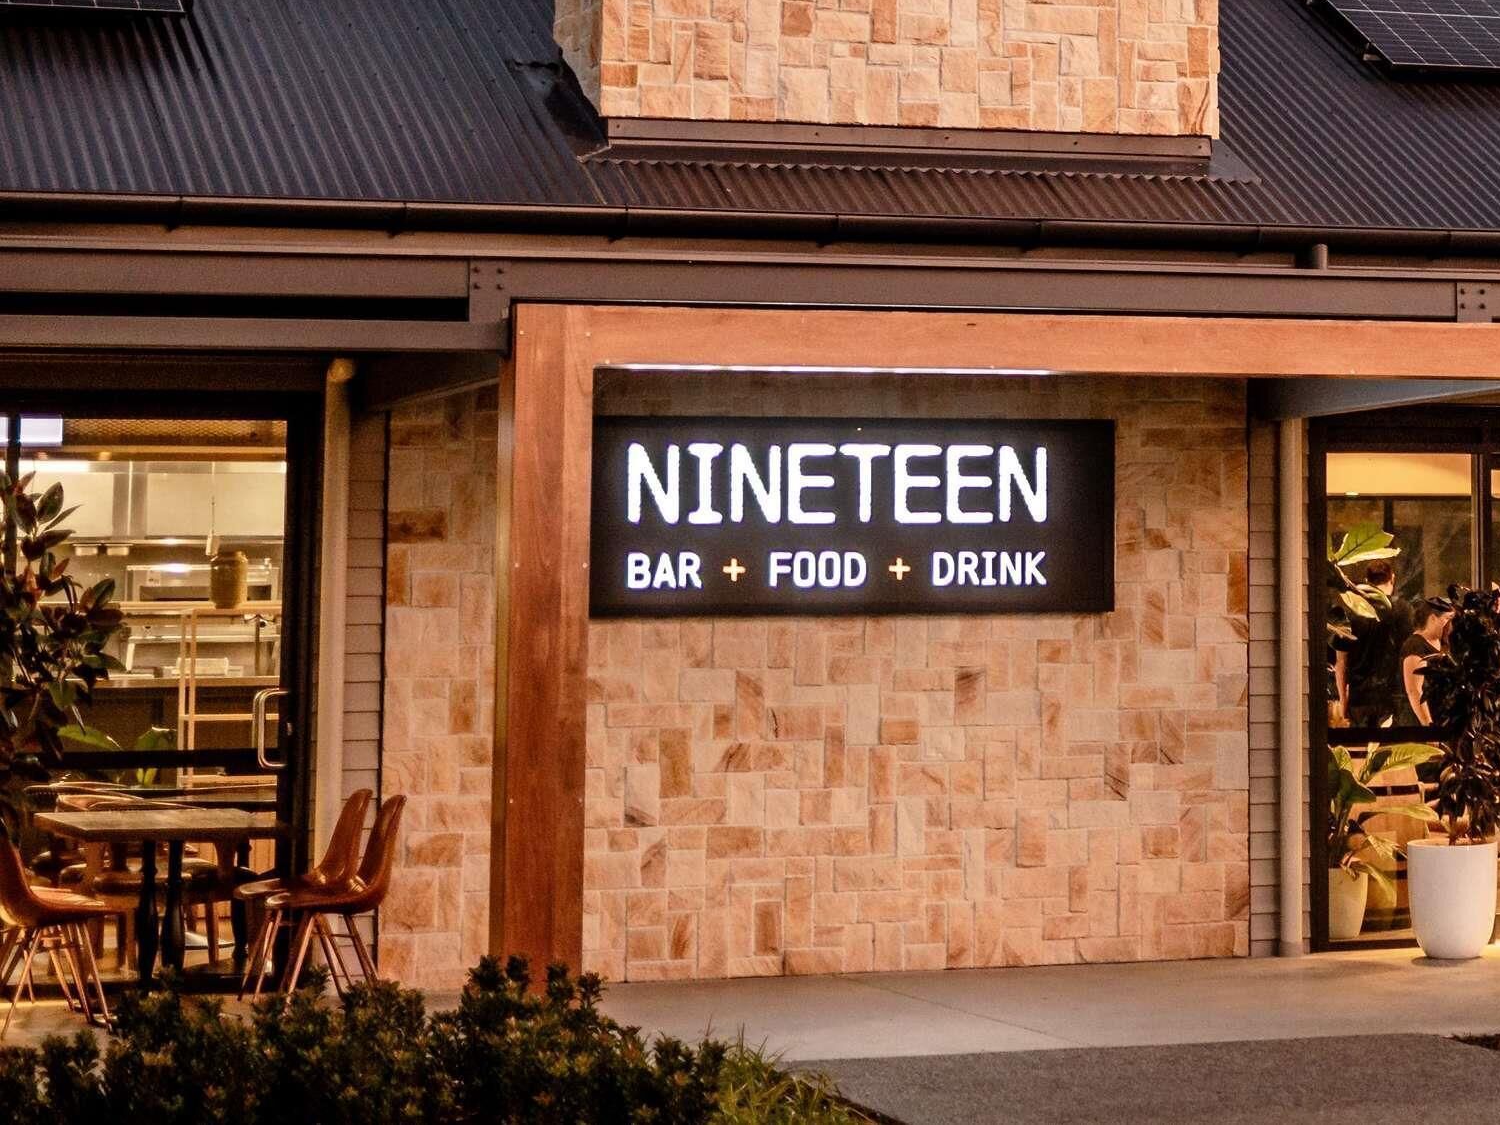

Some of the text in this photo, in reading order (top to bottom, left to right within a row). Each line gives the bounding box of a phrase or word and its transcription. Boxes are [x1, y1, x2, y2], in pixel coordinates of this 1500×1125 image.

[626, 441, 1049, 526] NINETEEN
[626, 550, 1048, 590] BAR + FOOD + DRINK
